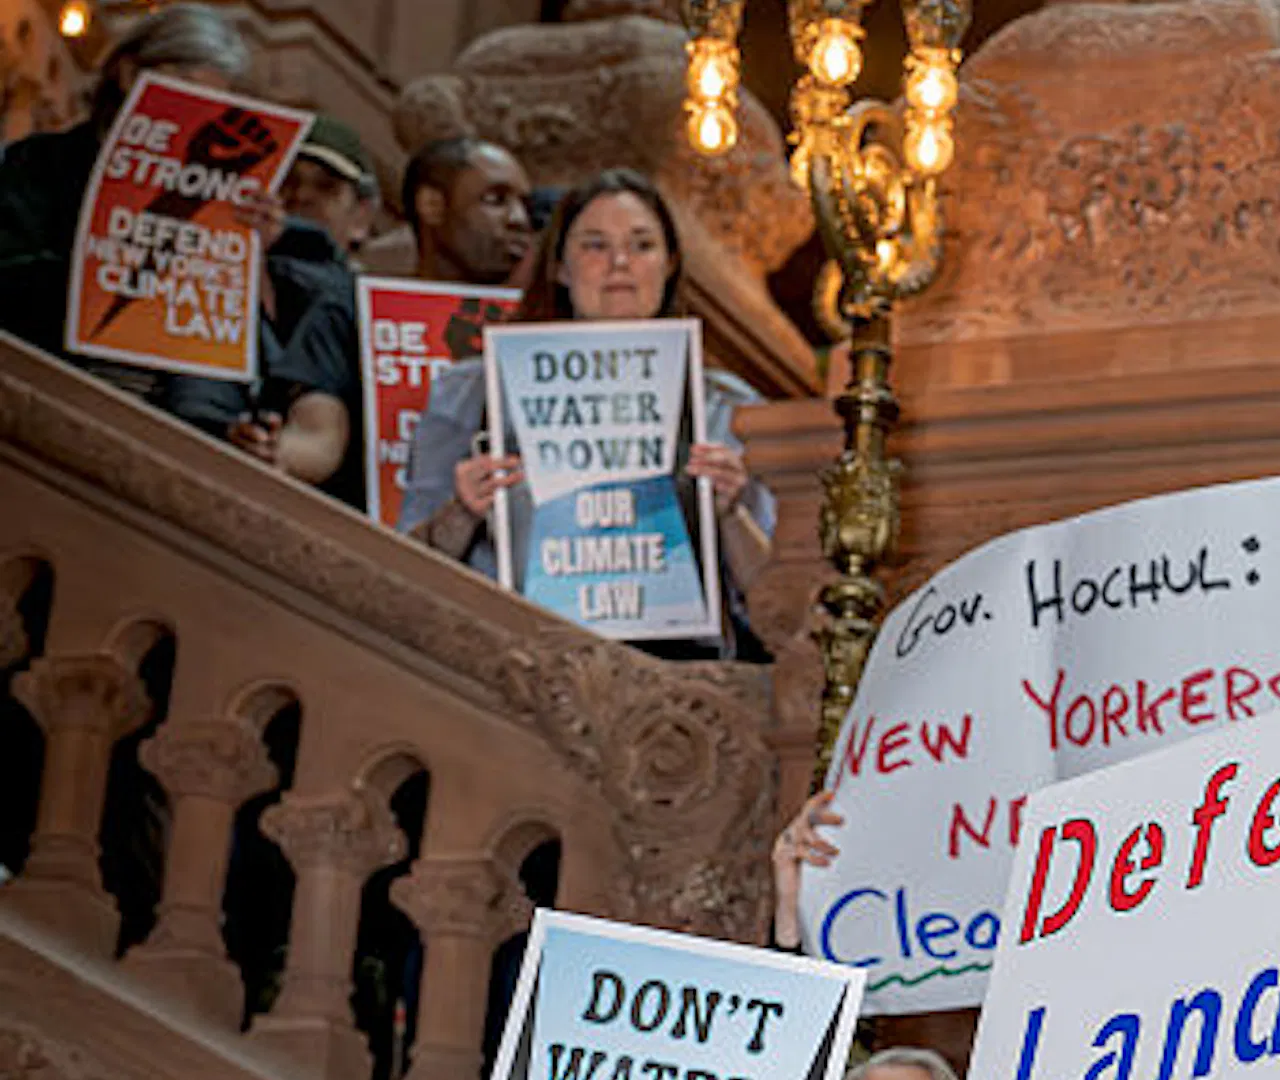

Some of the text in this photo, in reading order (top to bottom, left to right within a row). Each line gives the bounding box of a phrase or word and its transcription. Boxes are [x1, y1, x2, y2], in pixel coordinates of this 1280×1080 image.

[121, 114, 179, 150] BE
[105, 147, 266, 206] STRONG
[108, 206, 247, 264] DEFEND
[96, 263, 245, 318] CLIMATE
[165, 306, 244, 345] LAW
[373, 319, 428, 352] BE
[532, 347, 660, 383] DON'T
[520, 391, 663, 428] WATER
[538, 437, 665, 472] DOWN
[575, 488, 636, 528] OUR
[540, 532, 667, 576] CLIMATE
[579, 583, 645, 620] LAW
[836, 714, 974, 792] NEW
[582, 970, 785, 1053] DON'T
